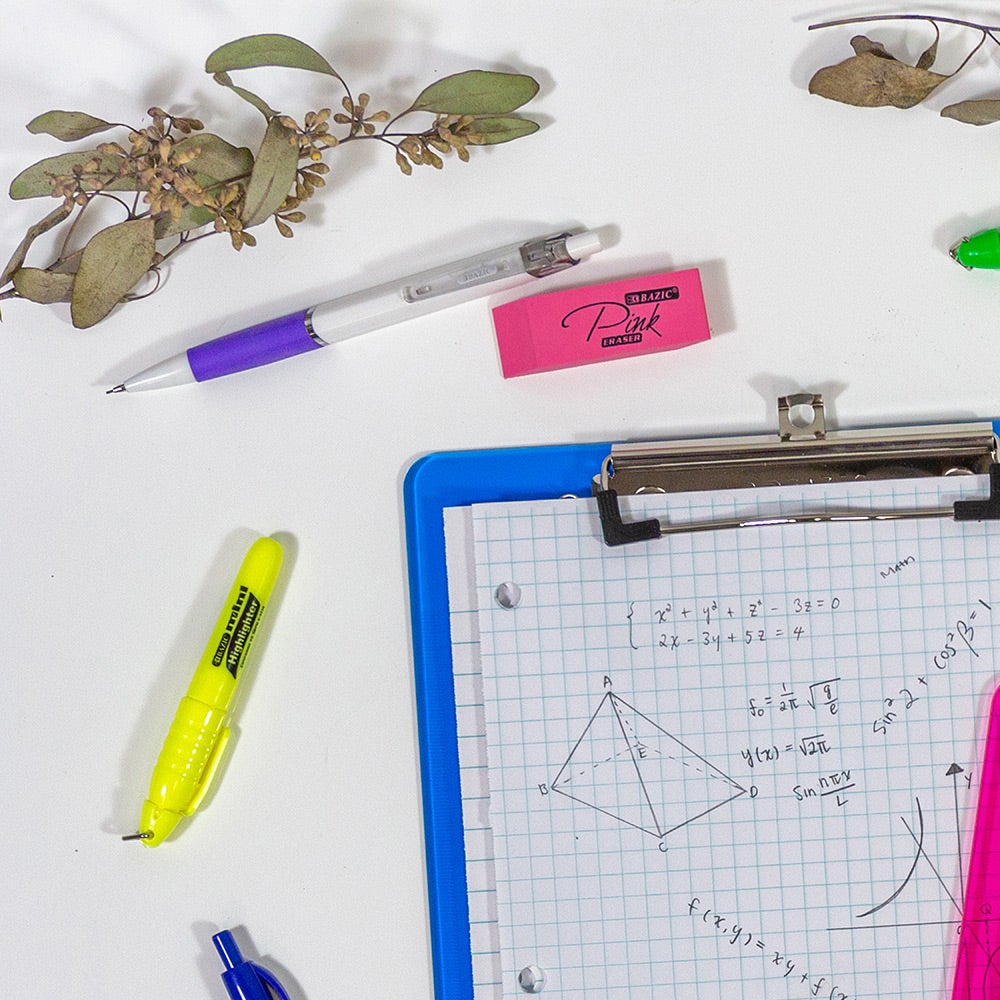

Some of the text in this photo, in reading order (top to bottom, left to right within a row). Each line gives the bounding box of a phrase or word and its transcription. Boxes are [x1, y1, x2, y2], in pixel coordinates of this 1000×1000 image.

[640, 289, 673, 302] BAZIC
[561, 301, 662, 342] Pink
[603, 334, 642, 347] ERASER
[225, 585, 249, 631] mini
[228, 599, 259, 665] Highlighter
